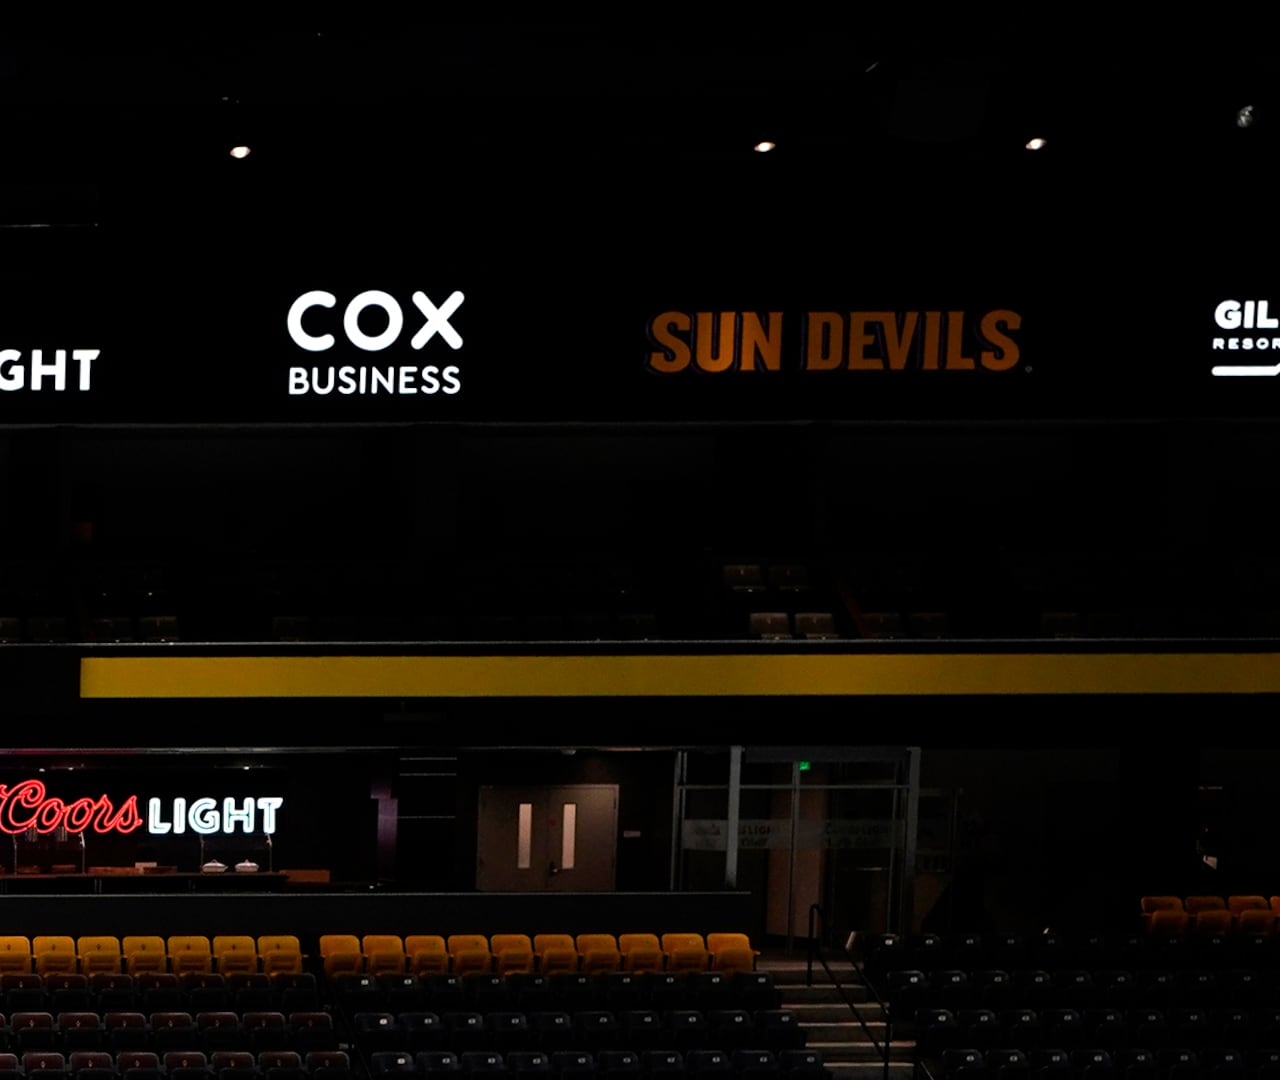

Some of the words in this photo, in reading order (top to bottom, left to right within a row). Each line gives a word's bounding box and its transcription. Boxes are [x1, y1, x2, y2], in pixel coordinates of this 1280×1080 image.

[287, 290, 464, 351] COX
[650, 311, 783, 372] SUN
[802, 309, 1022, 371] DEVILS
[289, 366, 460, 394] BUSINESS
[147, 796, 284, 836] LIGHT
